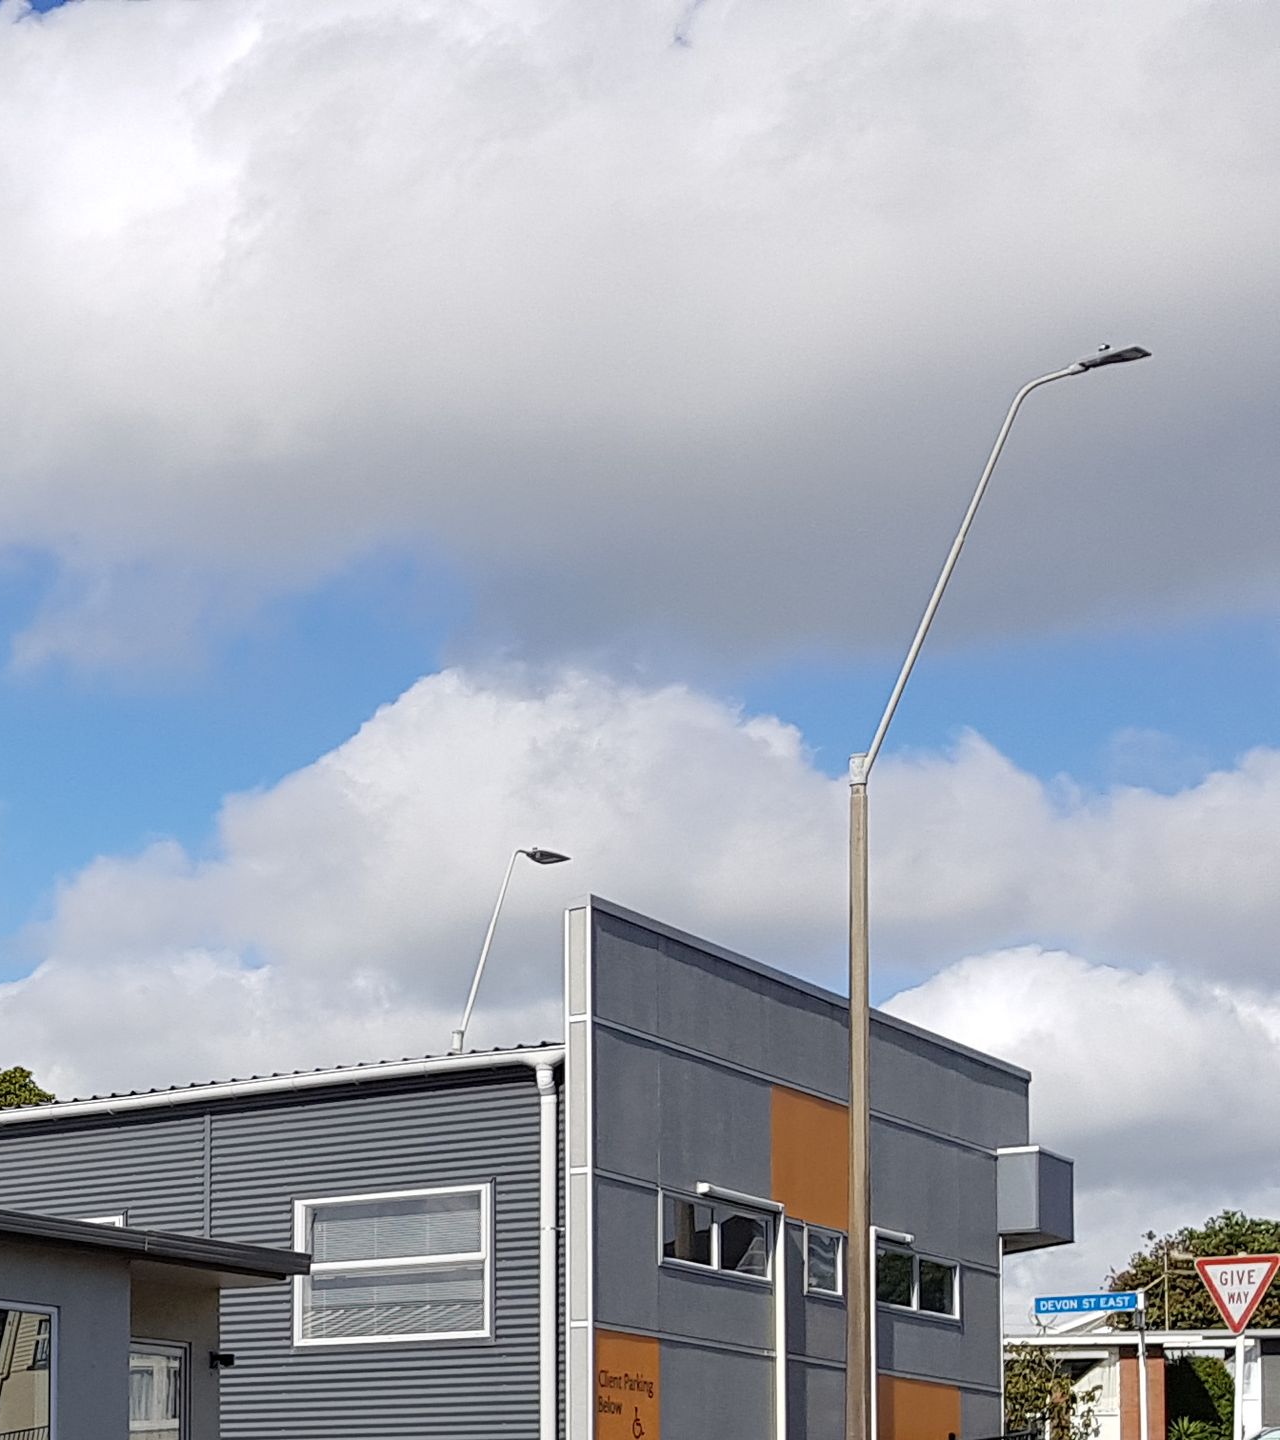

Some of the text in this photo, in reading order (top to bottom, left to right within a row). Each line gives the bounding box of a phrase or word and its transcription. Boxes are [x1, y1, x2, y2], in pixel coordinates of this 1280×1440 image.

[1220, 1269, 1256, 1286] GIVE
[1039, 1296, 1130, 1311] DEVON ST EAST
[1227, 1291, 1249, 1304] WAY
[598, 1370, 654, 1399] Client Parking
[598, 1395, 623, 1415] Below
